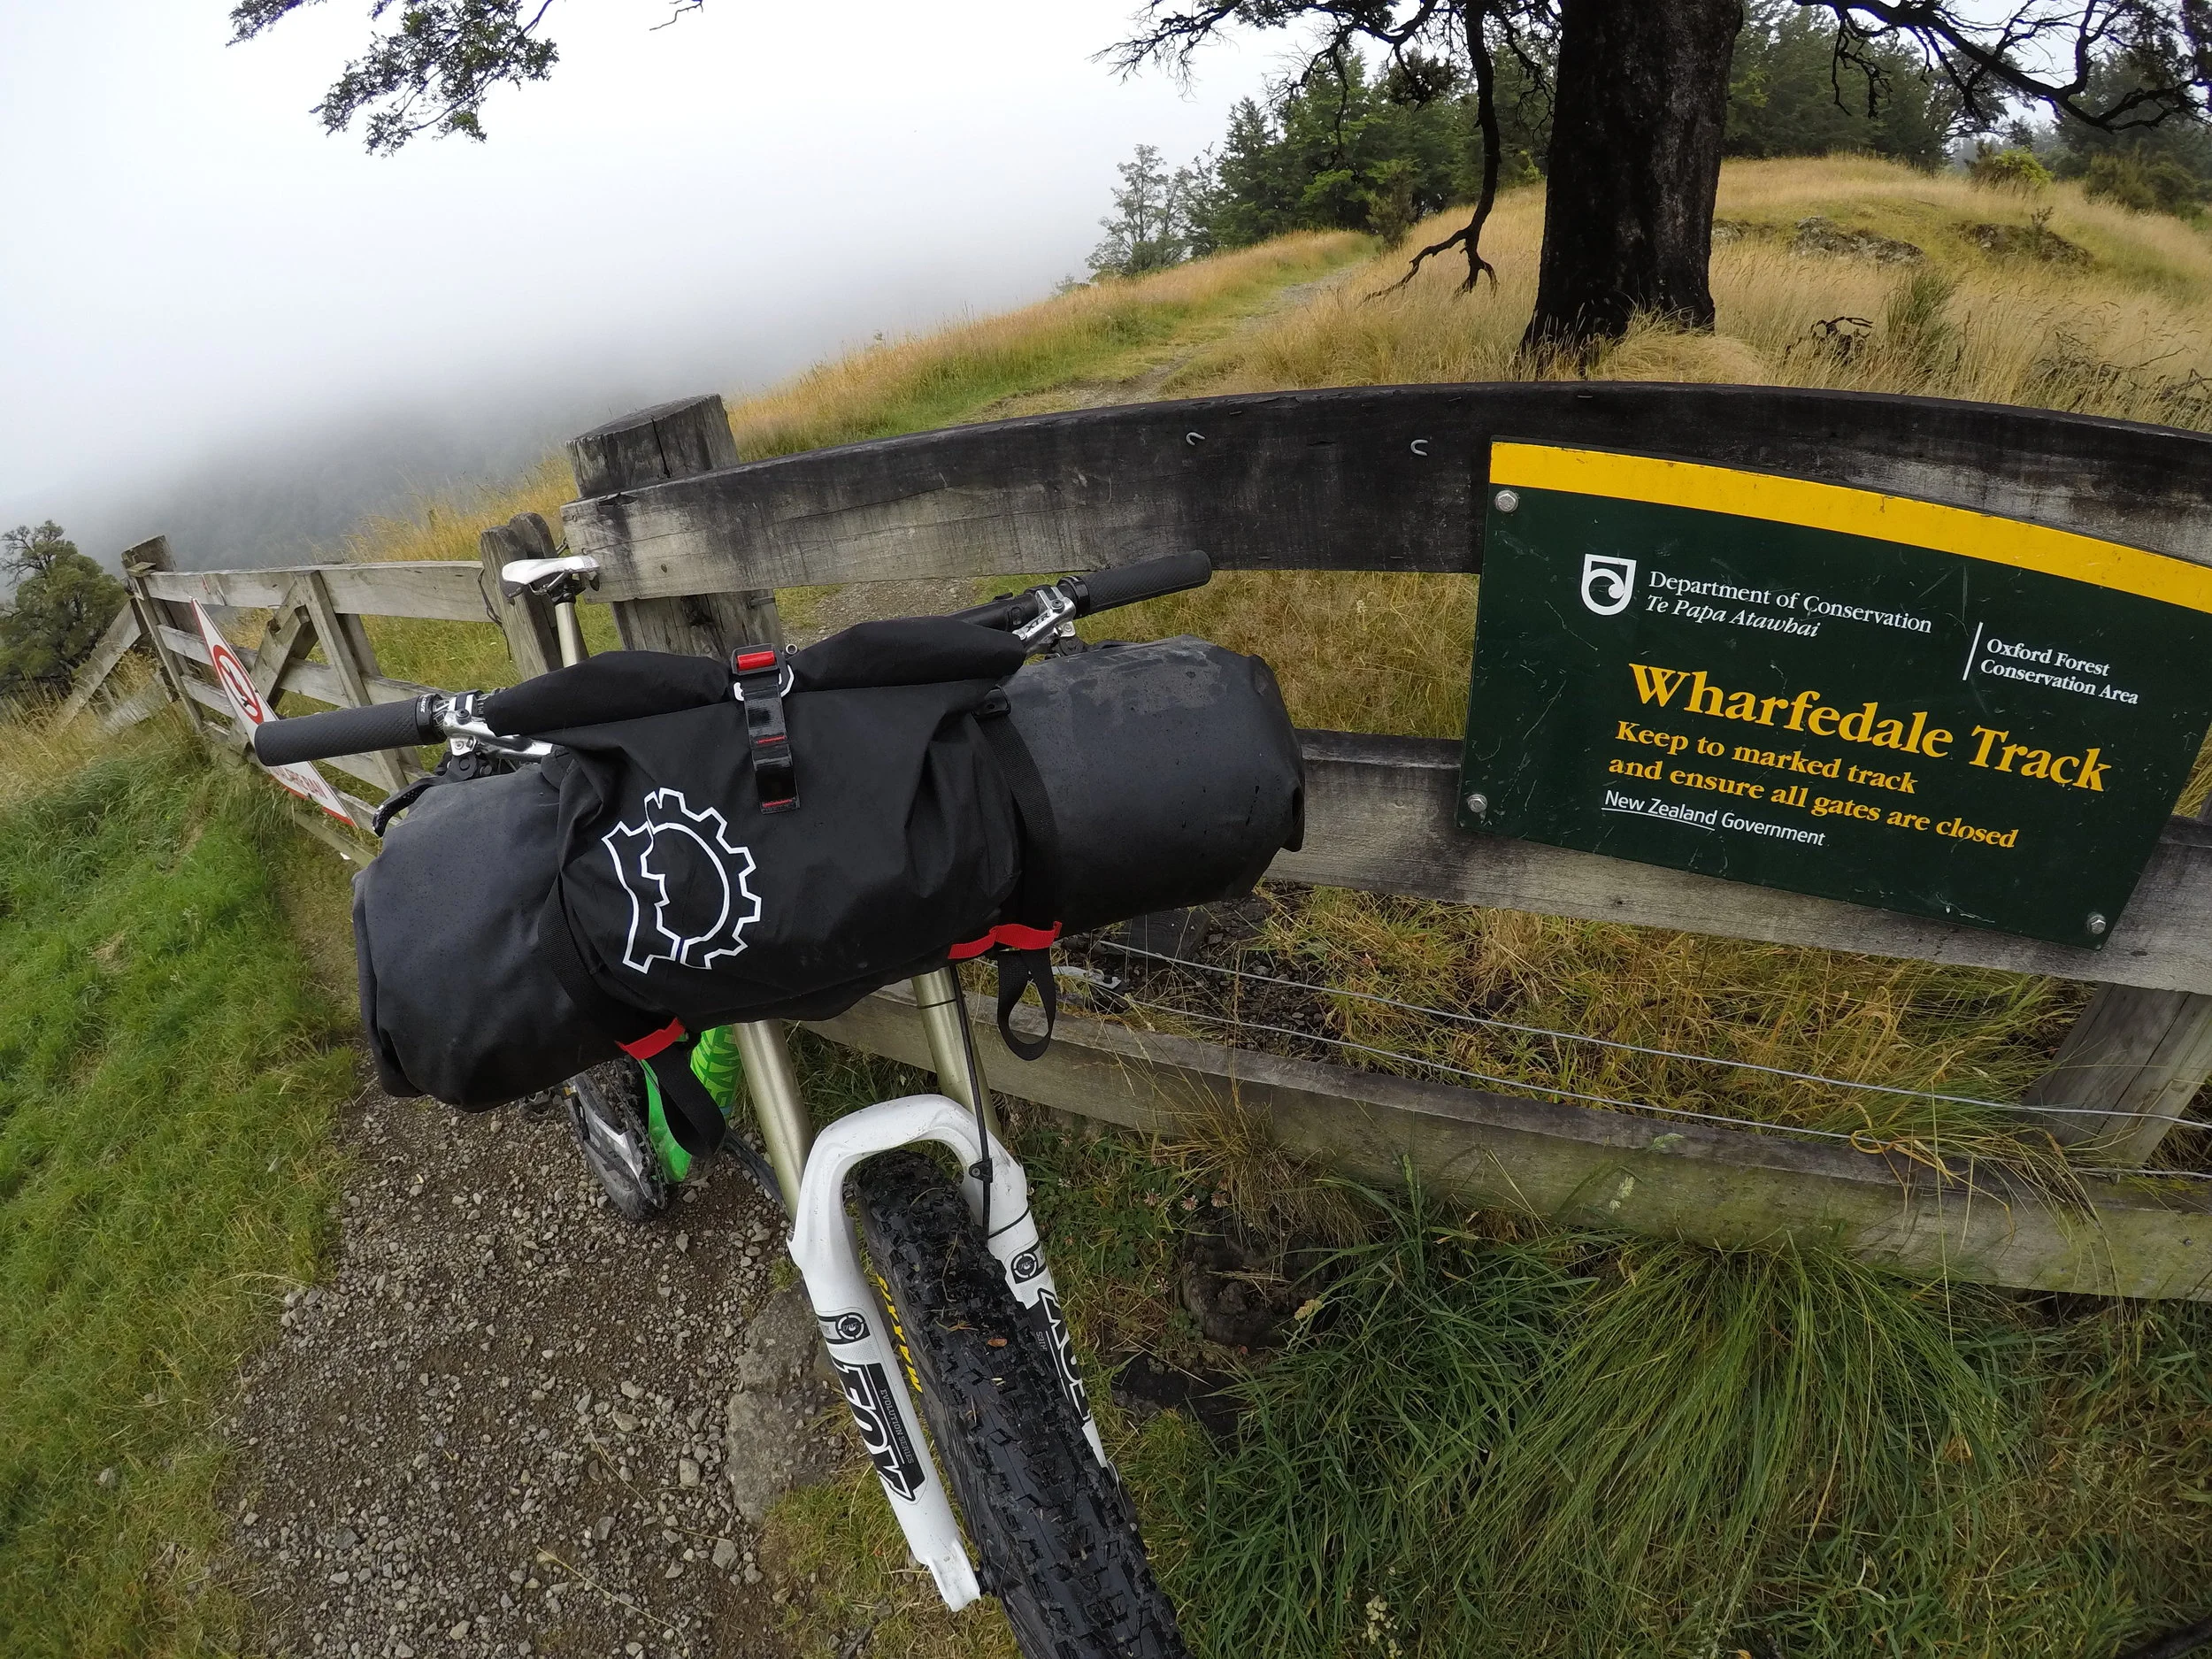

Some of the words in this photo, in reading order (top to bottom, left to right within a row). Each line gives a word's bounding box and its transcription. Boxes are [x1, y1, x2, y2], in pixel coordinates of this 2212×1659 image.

[1646, 595, 1669, 613] Te
[1671, 599, 1726, 624] Papa
[1729, 609, 1821, 637] Atawhai
[1649, 571, 1771, 604] Department
[1776, 592, 1801, 610] of
[1803, 595, 1932, 634] Conservation
[1980, 659, 2096, 695] Conservation
[2098, 684, 2139, 704] Area
[1986, 639, 2053, 664] Oxford
[2054, 652, 2110, 677] Forest
[1616, 720, 1688, 755] Keep
[1696, 737, 1724, 757] to
[1732, 745, 1840, 779] marked
[1847, 764, 1919, 794] track
[1628, 663, 1954, 758] Wharfedale
[1968, 725, 2112, 792] Track
[1604, 790, 1646, 811] New
[1648, 798, 1717, 826] Zealand
[1721, 812, 1825, 846] Government
[1609, 758, 1663, 780] and
[1670, 769, 1764, 799] ensure
[1770, 786, 1809, 808] all
[1810, 796, 1881, 821] gates
[1886, 810, 1931, 831] are
[1936, 818, 2019, 849] closed
[832, 1359, 914, 1501] FOX
[879, 1388, 904, 1437] EVOLUTION
[898, 1433, 915, 1464] SERIES
